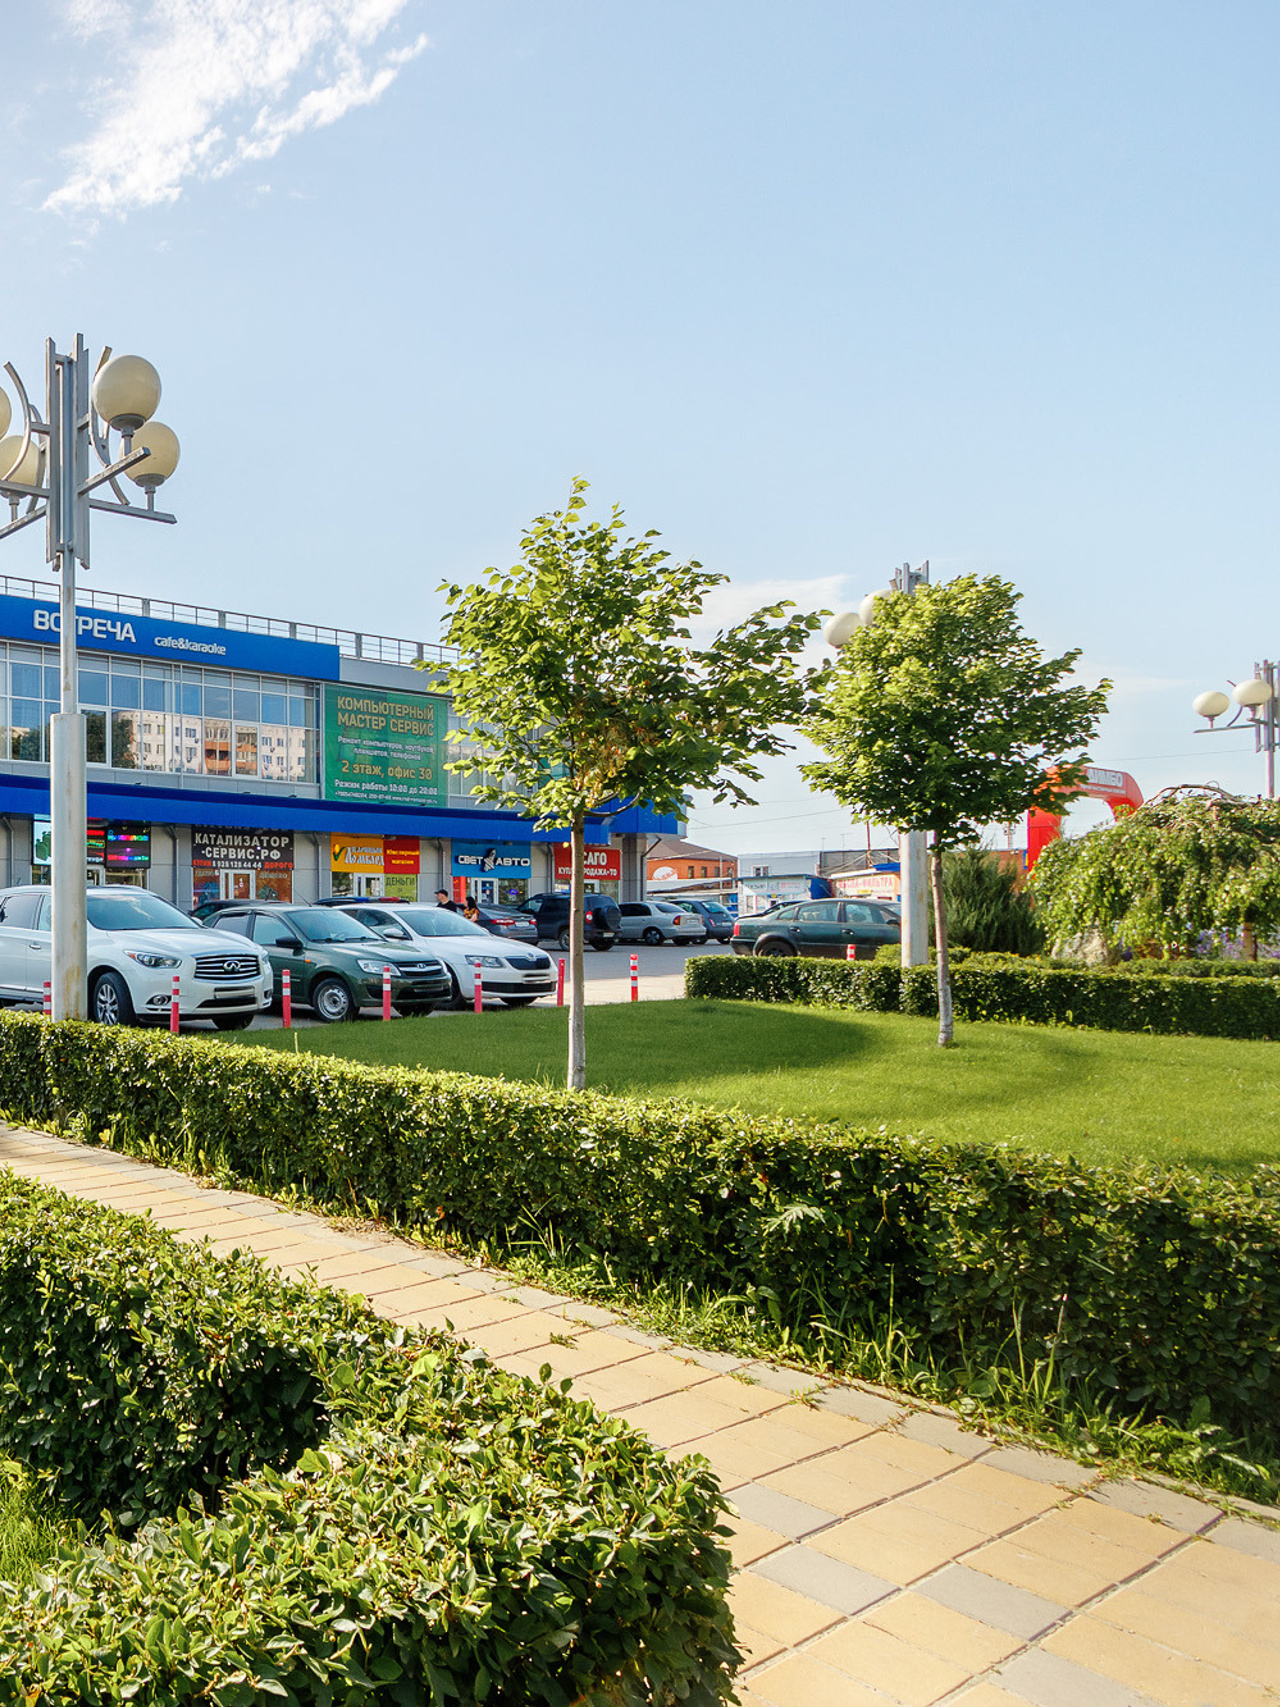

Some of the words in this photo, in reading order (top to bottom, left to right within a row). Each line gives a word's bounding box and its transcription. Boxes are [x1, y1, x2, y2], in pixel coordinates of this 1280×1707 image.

[154, 636, 227, 656] cafe&karaoke
[337, 695, 434, 721] КОМПЬЮТЕРНЫЙ
[337, 711, 387, 730] МАСТЕР
[389, 718, 435, 737] СЕРВИС
[341, 760, 350, 773] 2
[352, 763, 385, 778] этаж,
[387, 765, 416, 780] офис
[418, 767, 433, 780] 30
[334, 779, 360, 789] Режим
[361, 781, 389, 792] работы
[195, 832, 289, 848] КАТАЛИЗАТОР
[201, 846, 281, 860] -СЕРВИС.РФ
[458, 855, 483, 865] СВЕТ
[495, 857, 531, 867] АВТО
[386, 877, 415, 887] ДЕНЬГИ
